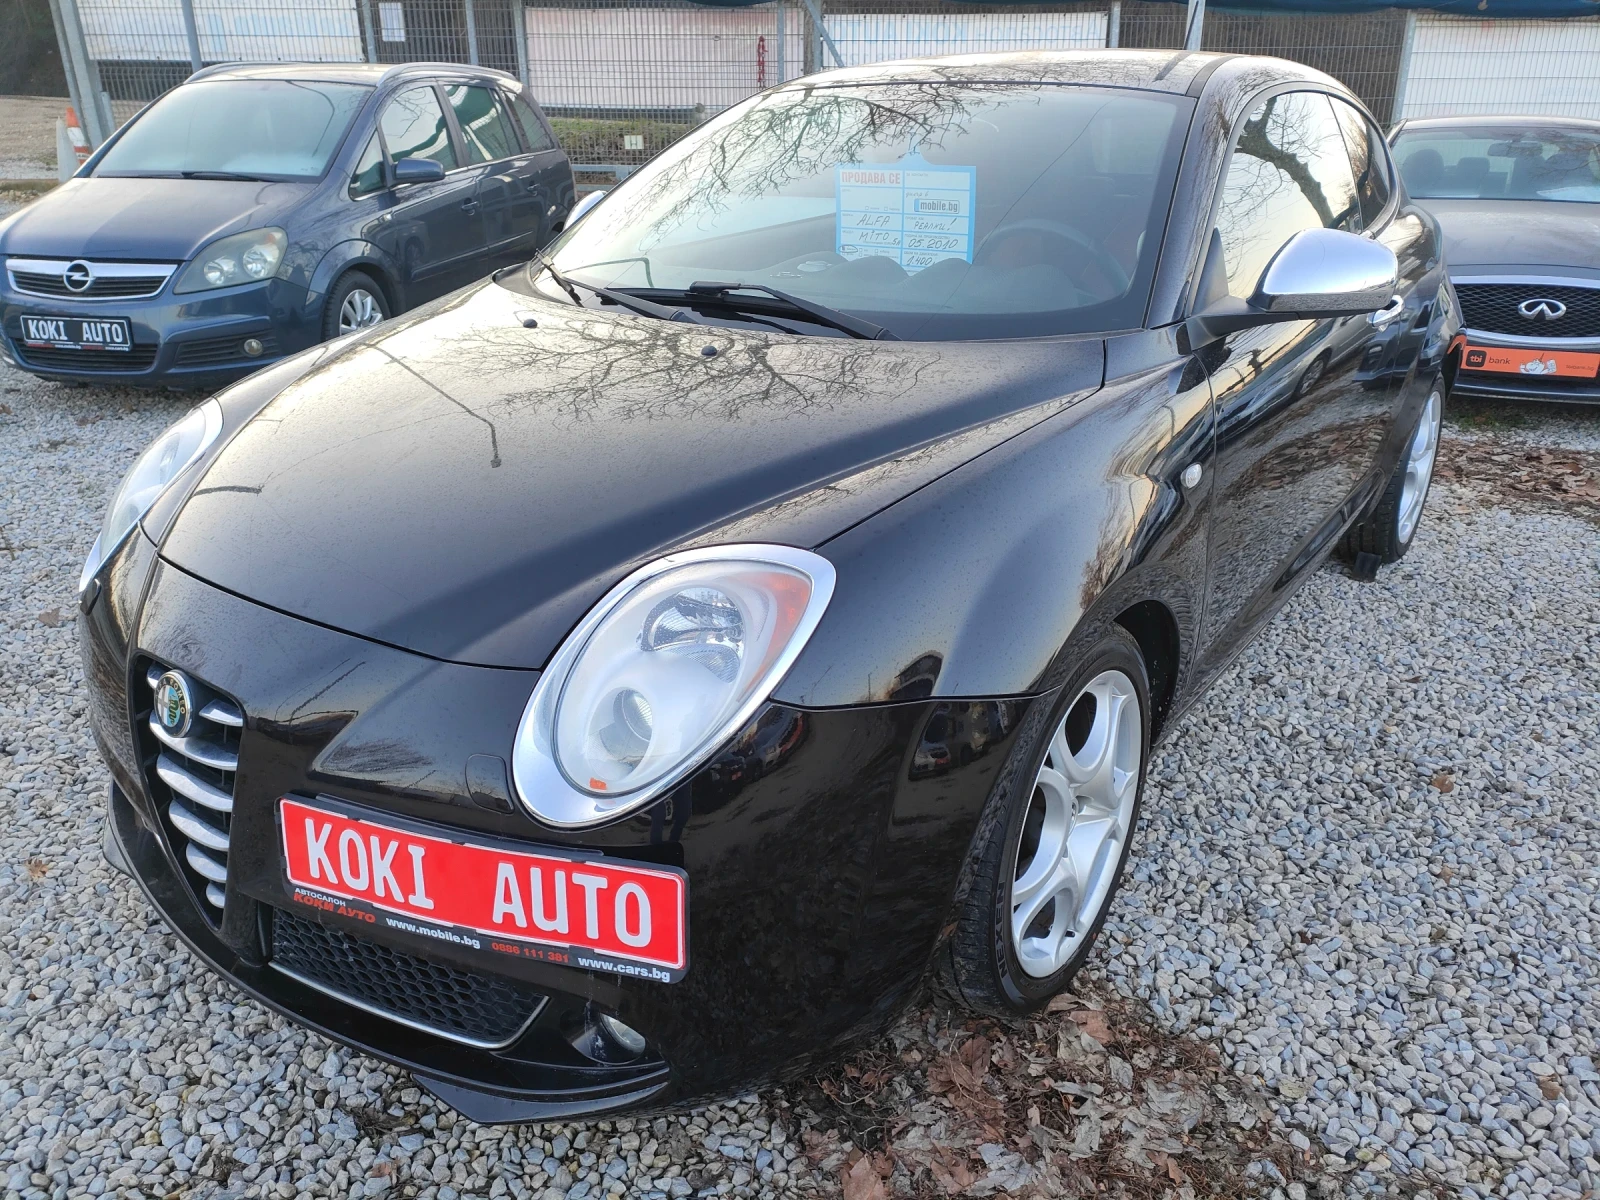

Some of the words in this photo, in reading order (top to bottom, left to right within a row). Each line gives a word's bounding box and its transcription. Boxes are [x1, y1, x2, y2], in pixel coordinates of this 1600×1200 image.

[841, 172, 886, 184] ПРОДАВА
[889, 173, 901, 184] СЕ
[920, 200, 958, 213] mobile.bg
[856, 213, 891, 228] ALFA
[908, 238, 959, 250] 05.2010
[28, 319, 68, 341] KOKI
[82, 322, 123, 342] AUTO
[1469, 355, 1483, 363] tbi
[1488, 357, 1511, 365] bank
[305, 817, 435, 910] KOKI
[492, 862, 652, 948] AUTO
[295, 887, 346, 907] АВТОСАЛОН
[293, 892, 334, 912] КОКИ
[337, 906, 376, 923] АУТО
[385, 917, 481, 949] www.mobile.bg
[995, 881, 1009, 979] NEXEN
[491, 942, 520, 955] 0886
[523, 948, 544, 959] 111
[547, 951, 569, 963] 381
[577, 956, 670, 983] www.cars.bg
